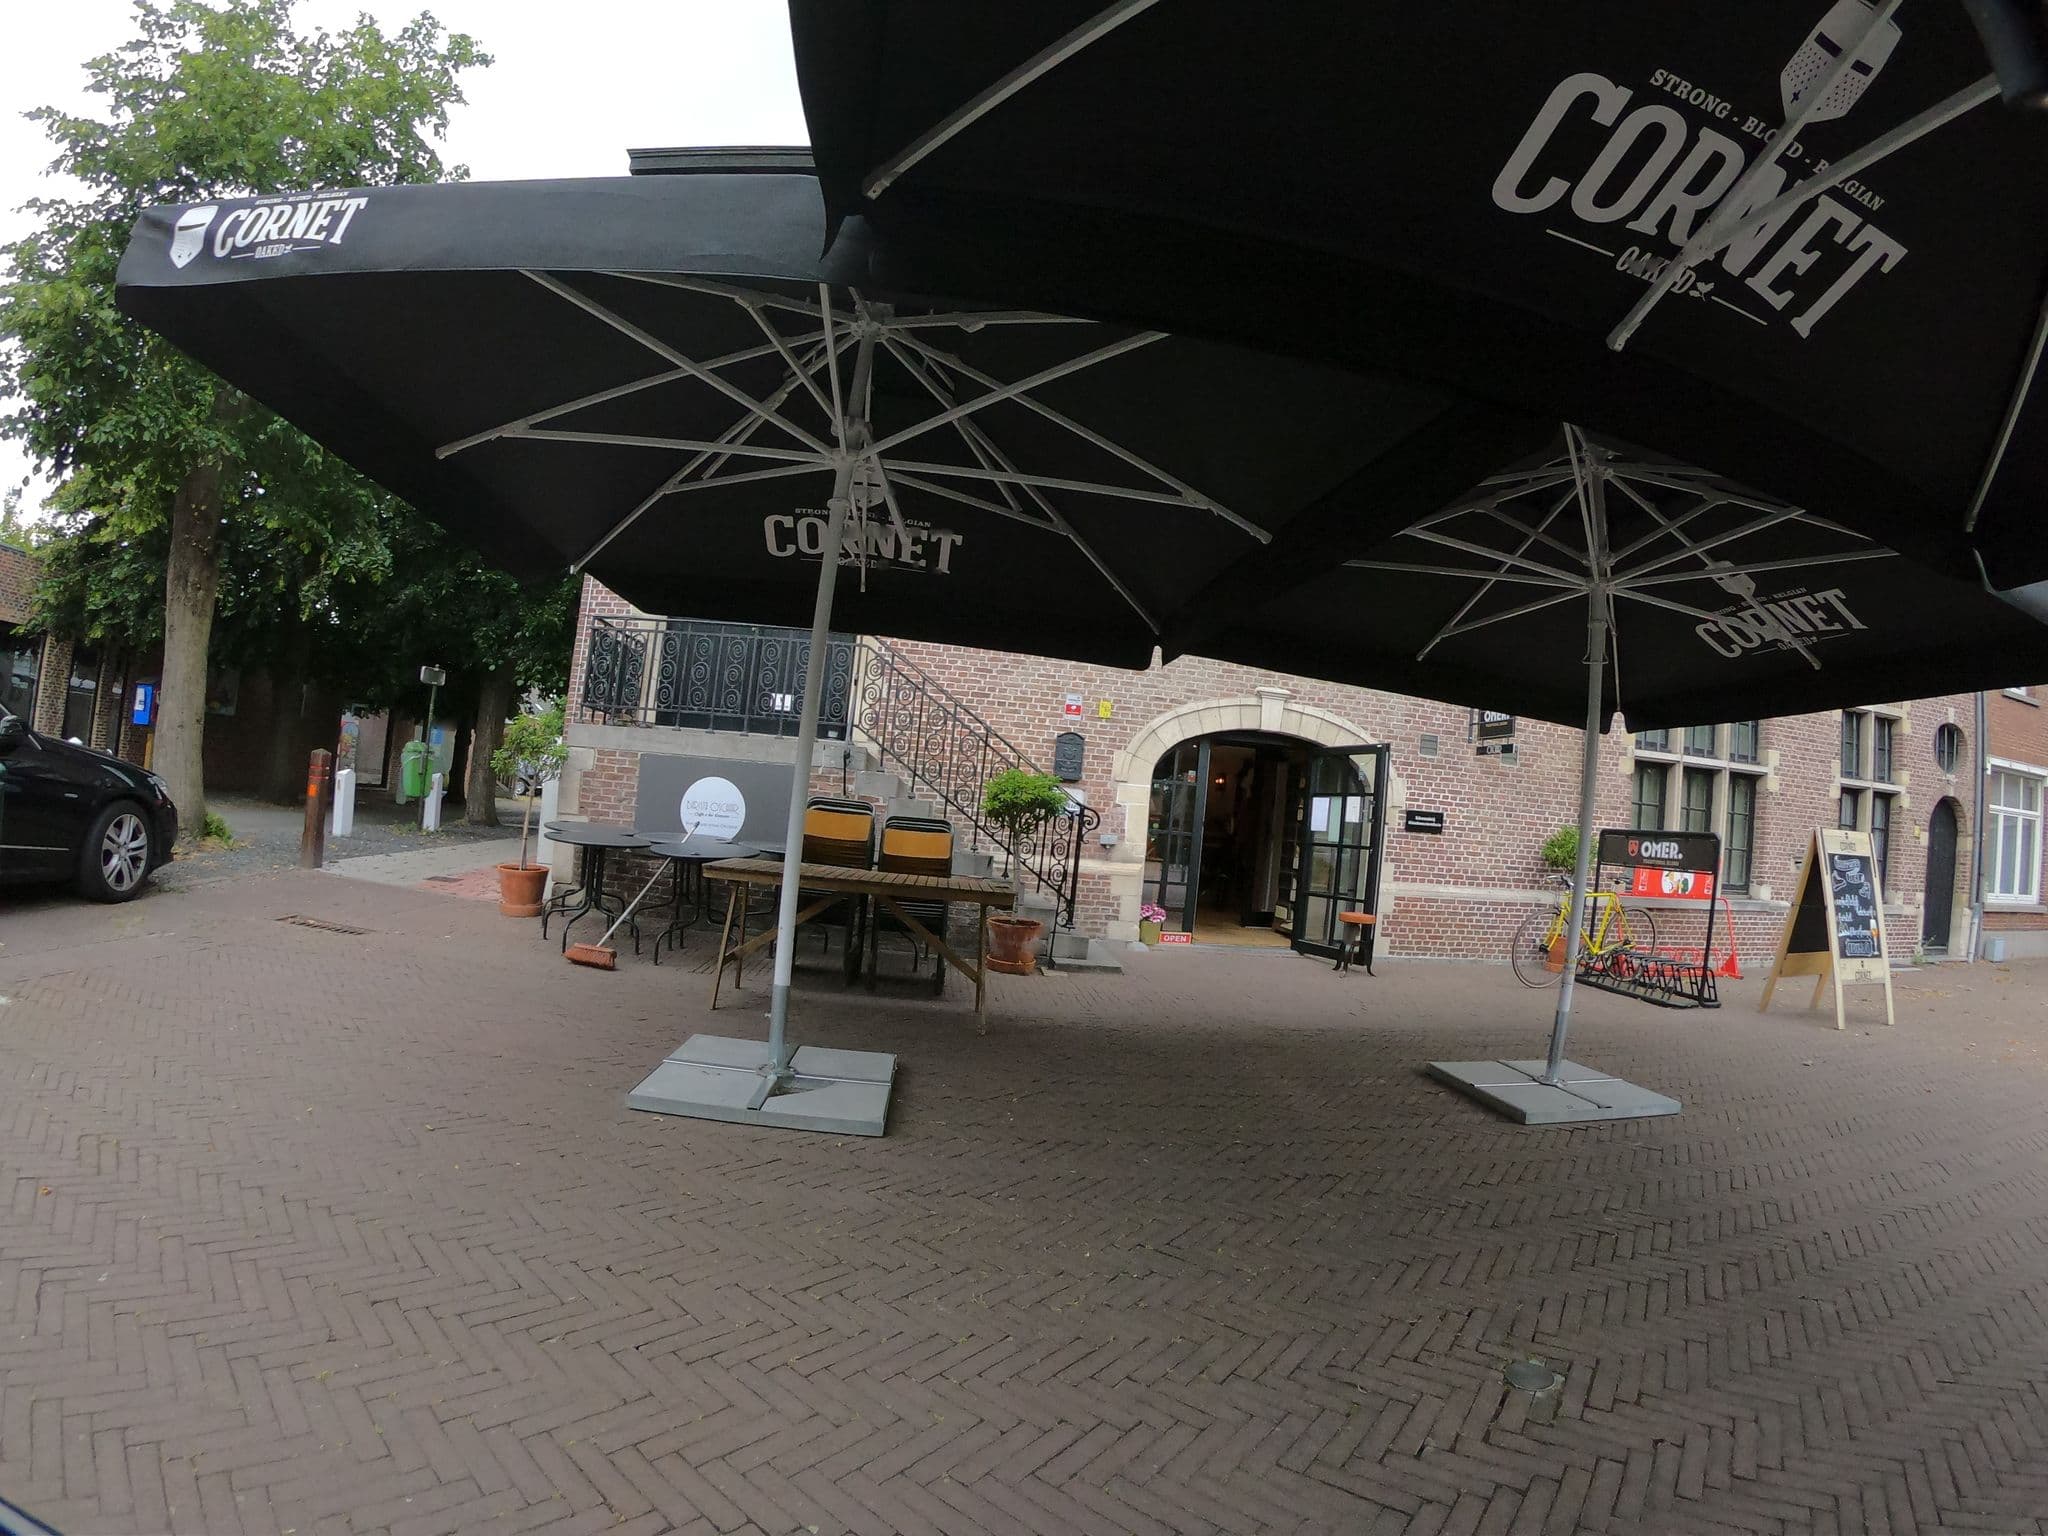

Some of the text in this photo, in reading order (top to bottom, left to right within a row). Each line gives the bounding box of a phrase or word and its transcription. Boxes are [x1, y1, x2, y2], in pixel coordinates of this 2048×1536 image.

[1649, 68, 1732, 119] STRONG
[1740, 116, 1804, 158] BLOD
[213, 196, 369, 258] CORNET
[255, 244, 286, 259] OAKED
[1641, 840, 1684, 860] OMER.
